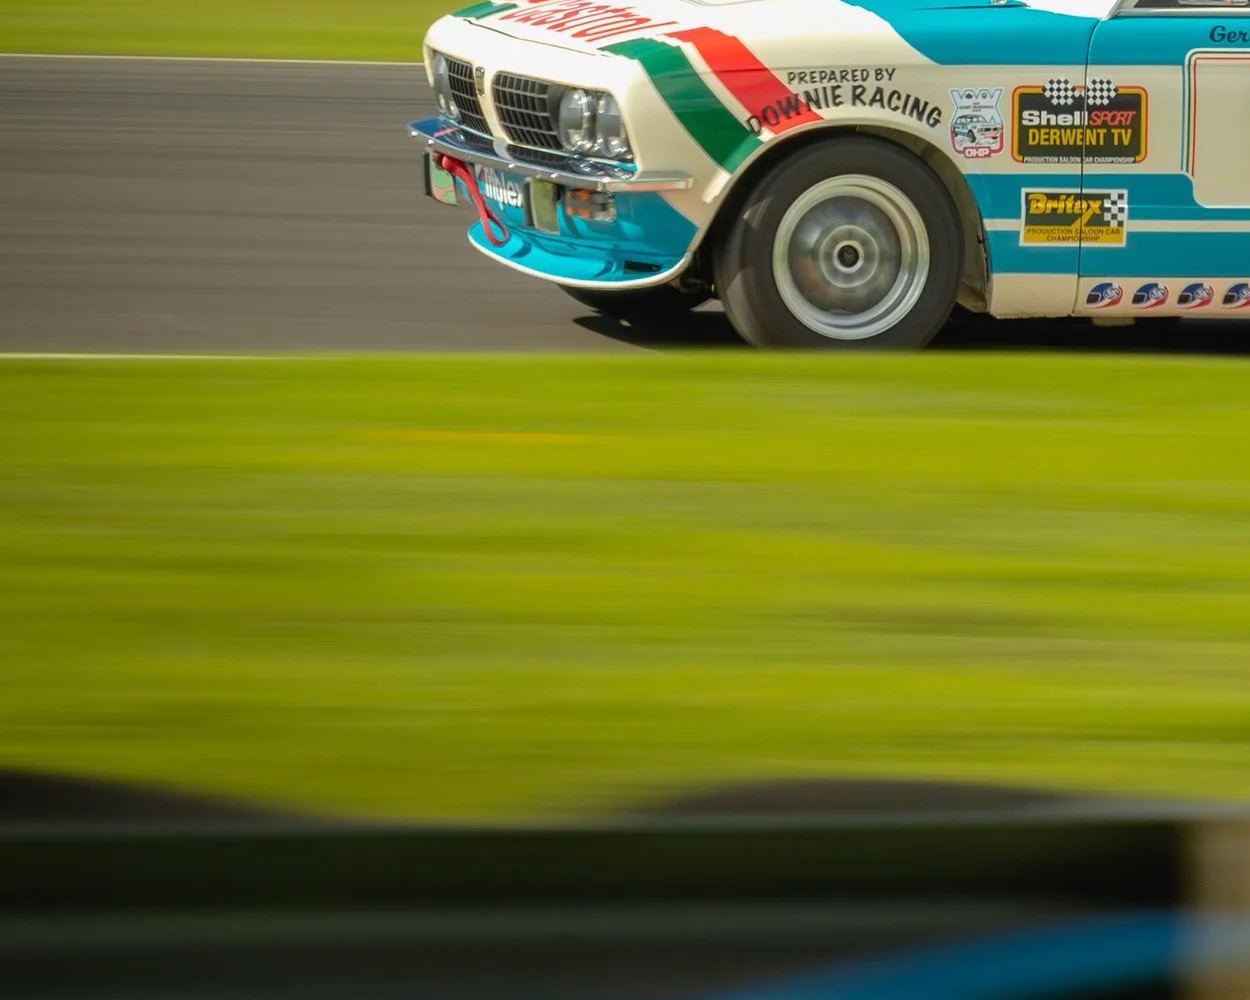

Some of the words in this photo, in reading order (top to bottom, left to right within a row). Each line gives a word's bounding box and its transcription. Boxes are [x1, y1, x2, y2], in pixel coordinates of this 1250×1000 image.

[787, 68, 870, 85] PREPARED
[874, 68, 896, 82] BY
[746, 84, 844, 136] DOWNIE
[851, 84, 943, 129] RACING
[1028, 128, 1107, 146] DERWENT
[1111, 128, 1132, 146] TV
